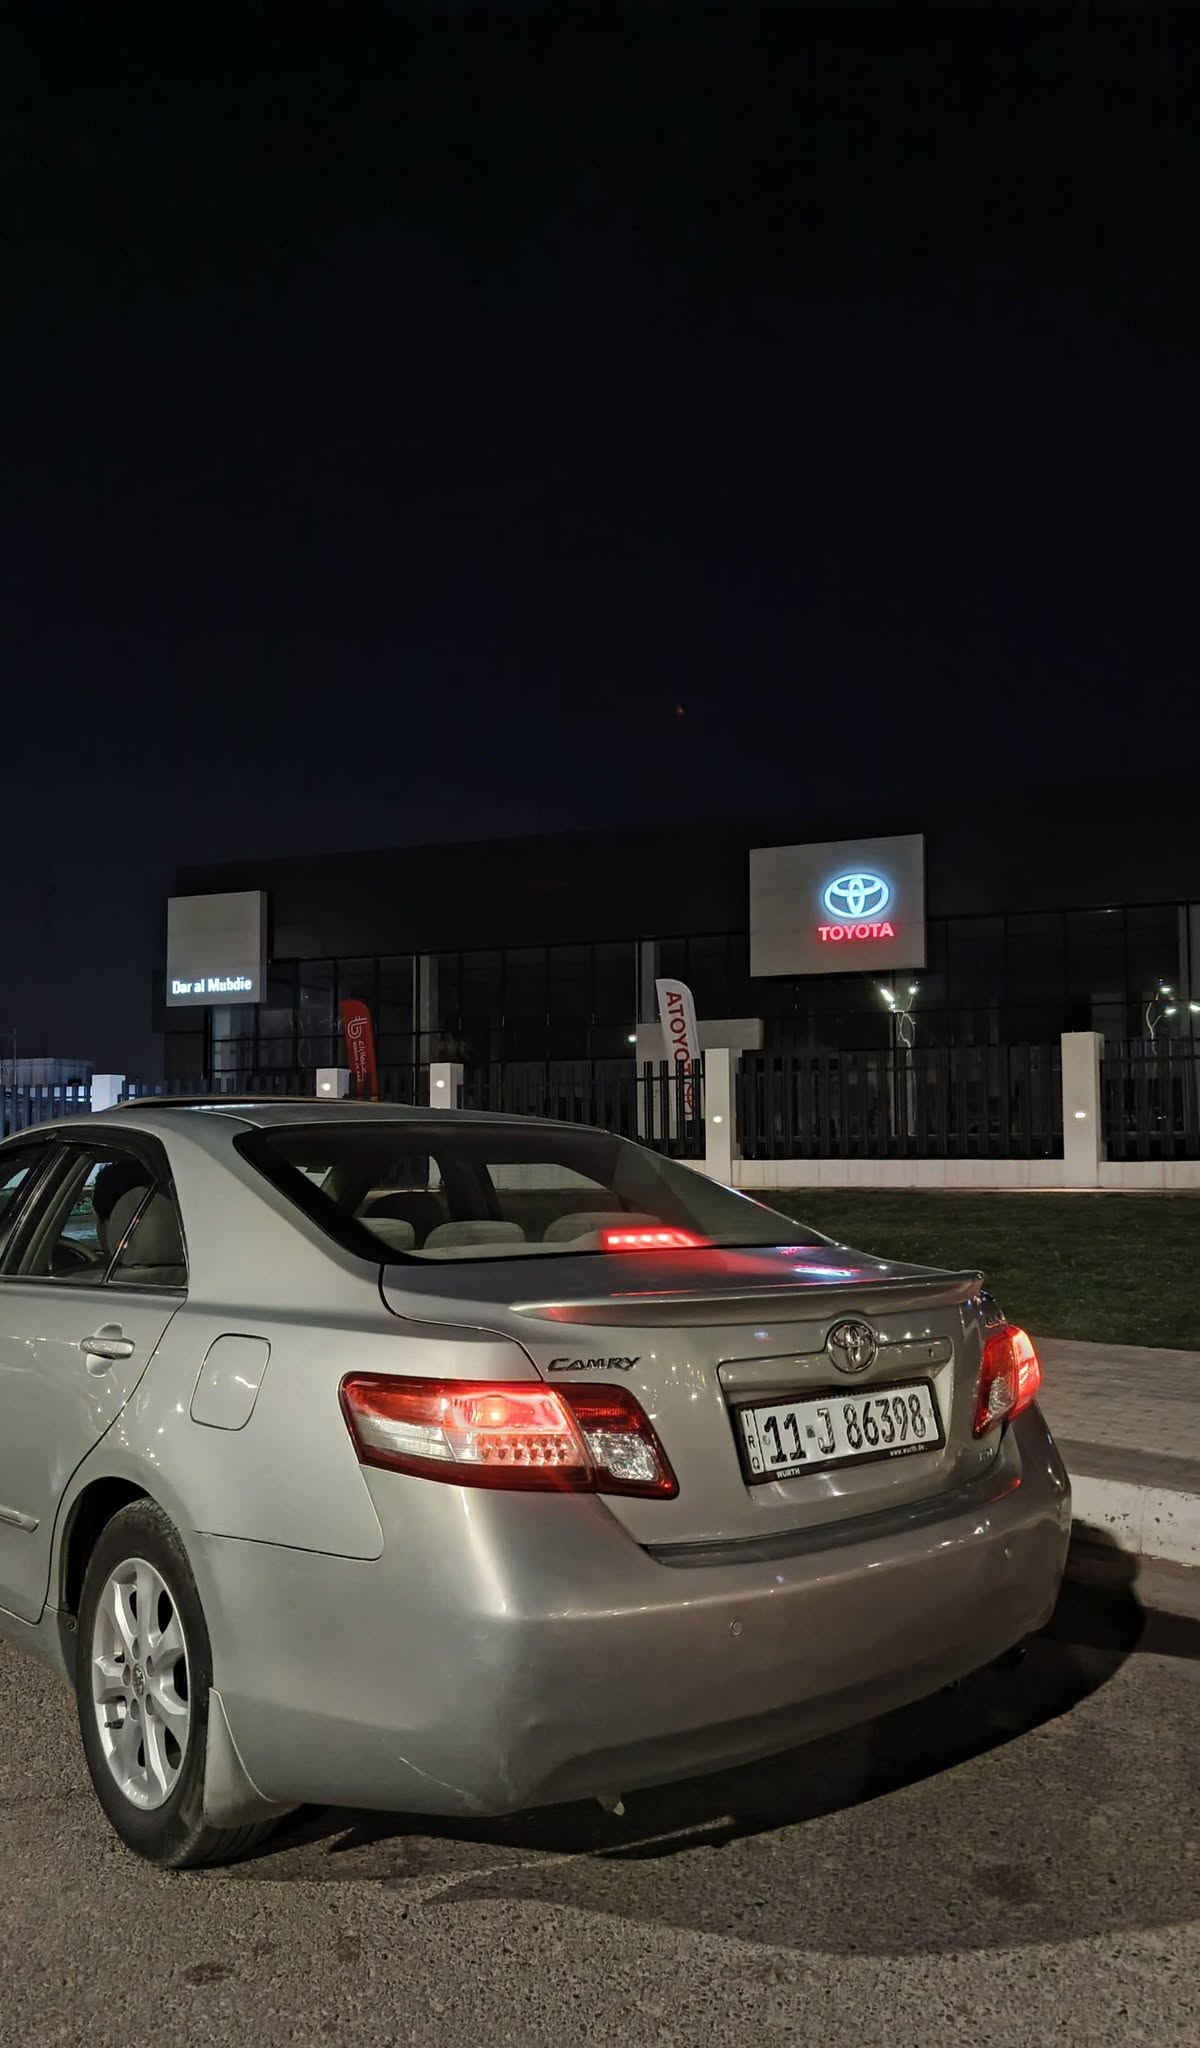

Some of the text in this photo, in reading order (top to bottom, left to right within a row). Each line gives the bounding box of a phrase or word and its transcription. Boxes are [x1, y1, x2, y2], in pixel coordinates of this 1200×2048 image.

[817, 922, 895, 941] TOYOTA
[172, 976, 252, 994] Dar al Mubdie
[548, 1356, 641, 1371] CAMRY
[843, 1393, 926, 1450] 86398
